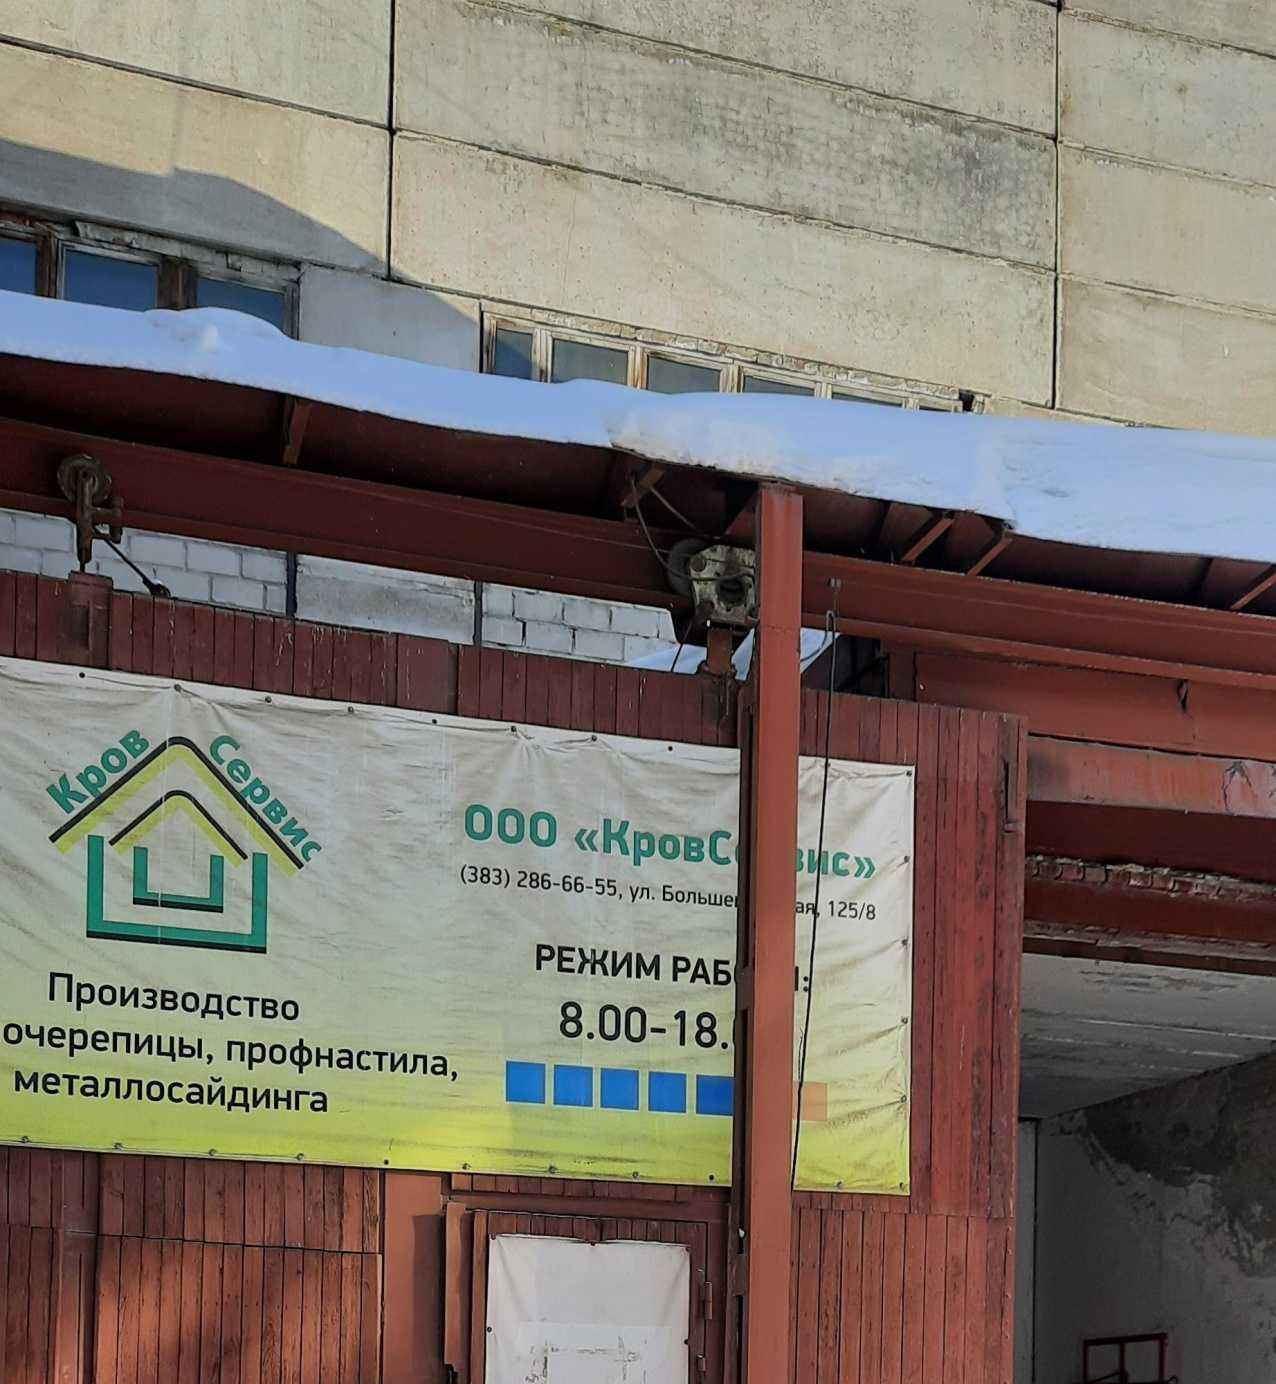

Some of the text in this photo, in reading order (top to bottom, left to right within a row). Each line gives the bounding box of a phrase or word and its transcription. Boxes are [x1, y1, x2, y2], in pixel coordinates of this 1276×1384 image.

[46, 729, 322, 863] Кров Сервис
[464, 803, 876, 880] ООО «КровСис»
[460, 864, 511, 888] (383)
[517, 870, 623, 900] 286-66-55,
[629, 885, 656, 903] ул.
[828, 901, 877, 921] 125/8
[535, 943, 661, 982] РЕЖИМ
[48, 971, 301, 1021] Производство
[559, 1000, 735, 1051] 8.00-18.
[226, 1039, 459, 1082] профнастила,
[14, 1069, 329, 1113] металлосайдинга
